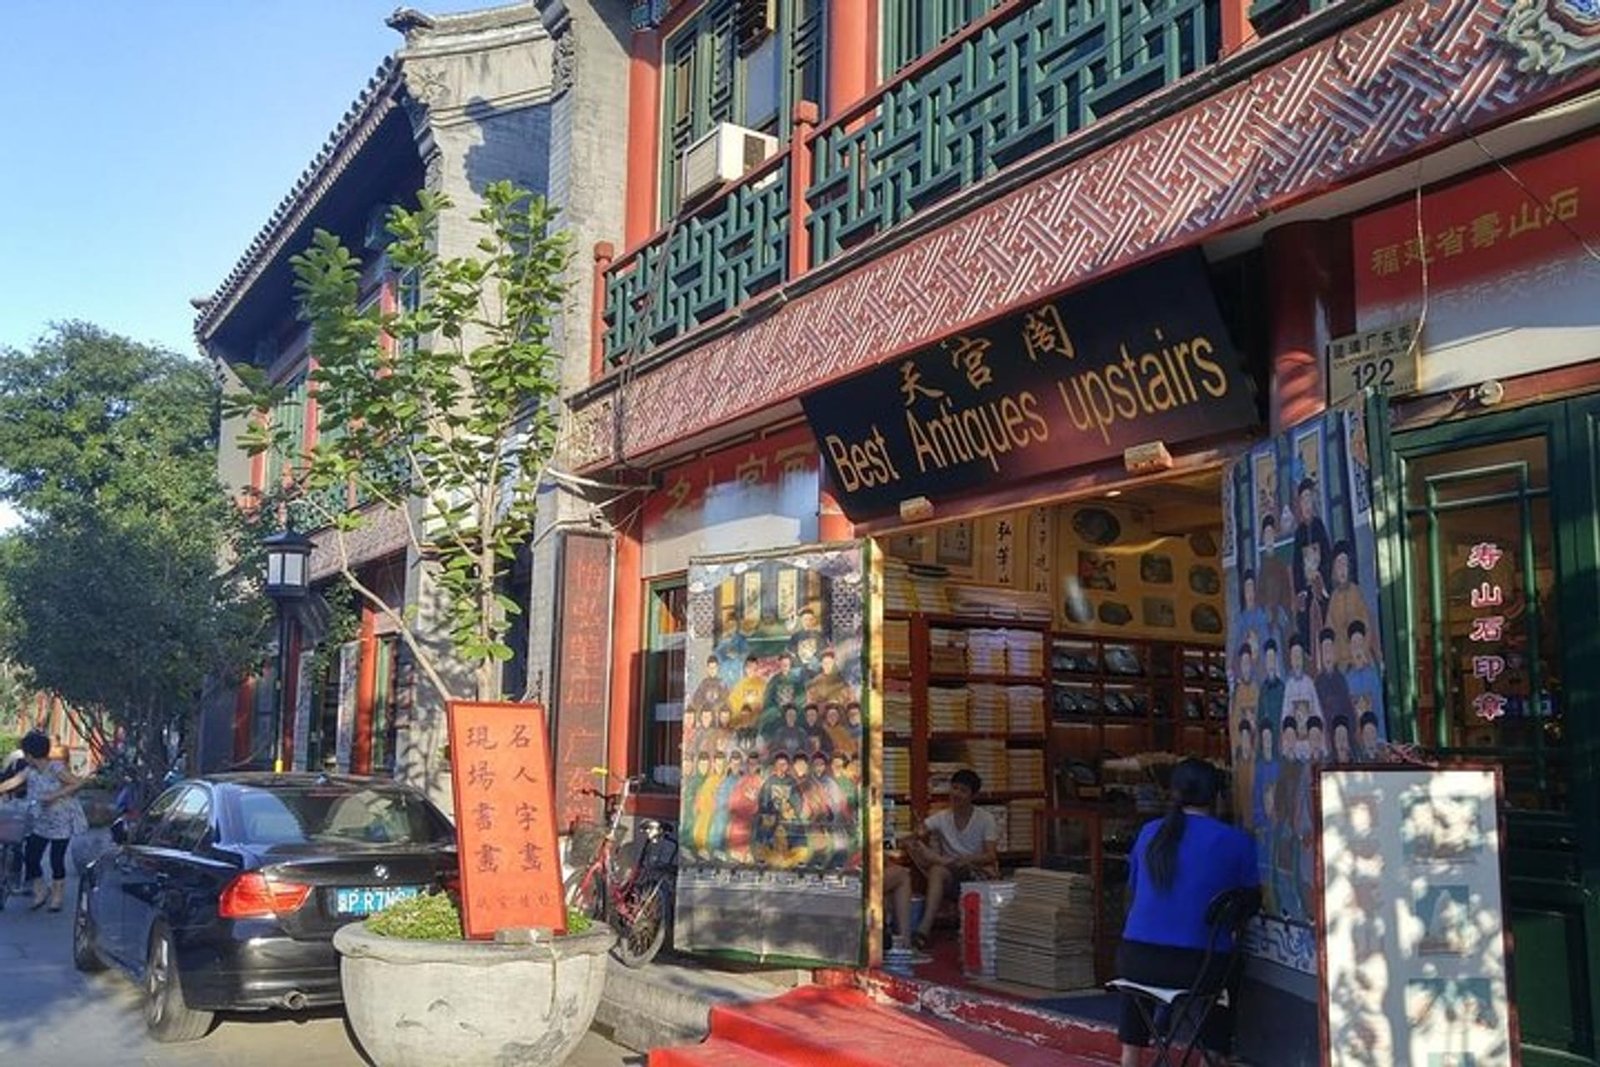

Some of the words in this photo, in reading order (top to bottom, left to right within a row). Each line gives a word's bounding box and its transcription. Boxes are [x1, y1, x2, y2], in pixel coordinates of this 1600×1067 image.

[826, 425, 900, 493] Best
[905, 397, 1050, 474] Antiques
[1057, 328, 1229, 446] upstairs
[1351, 358, 1396, 391] 122
